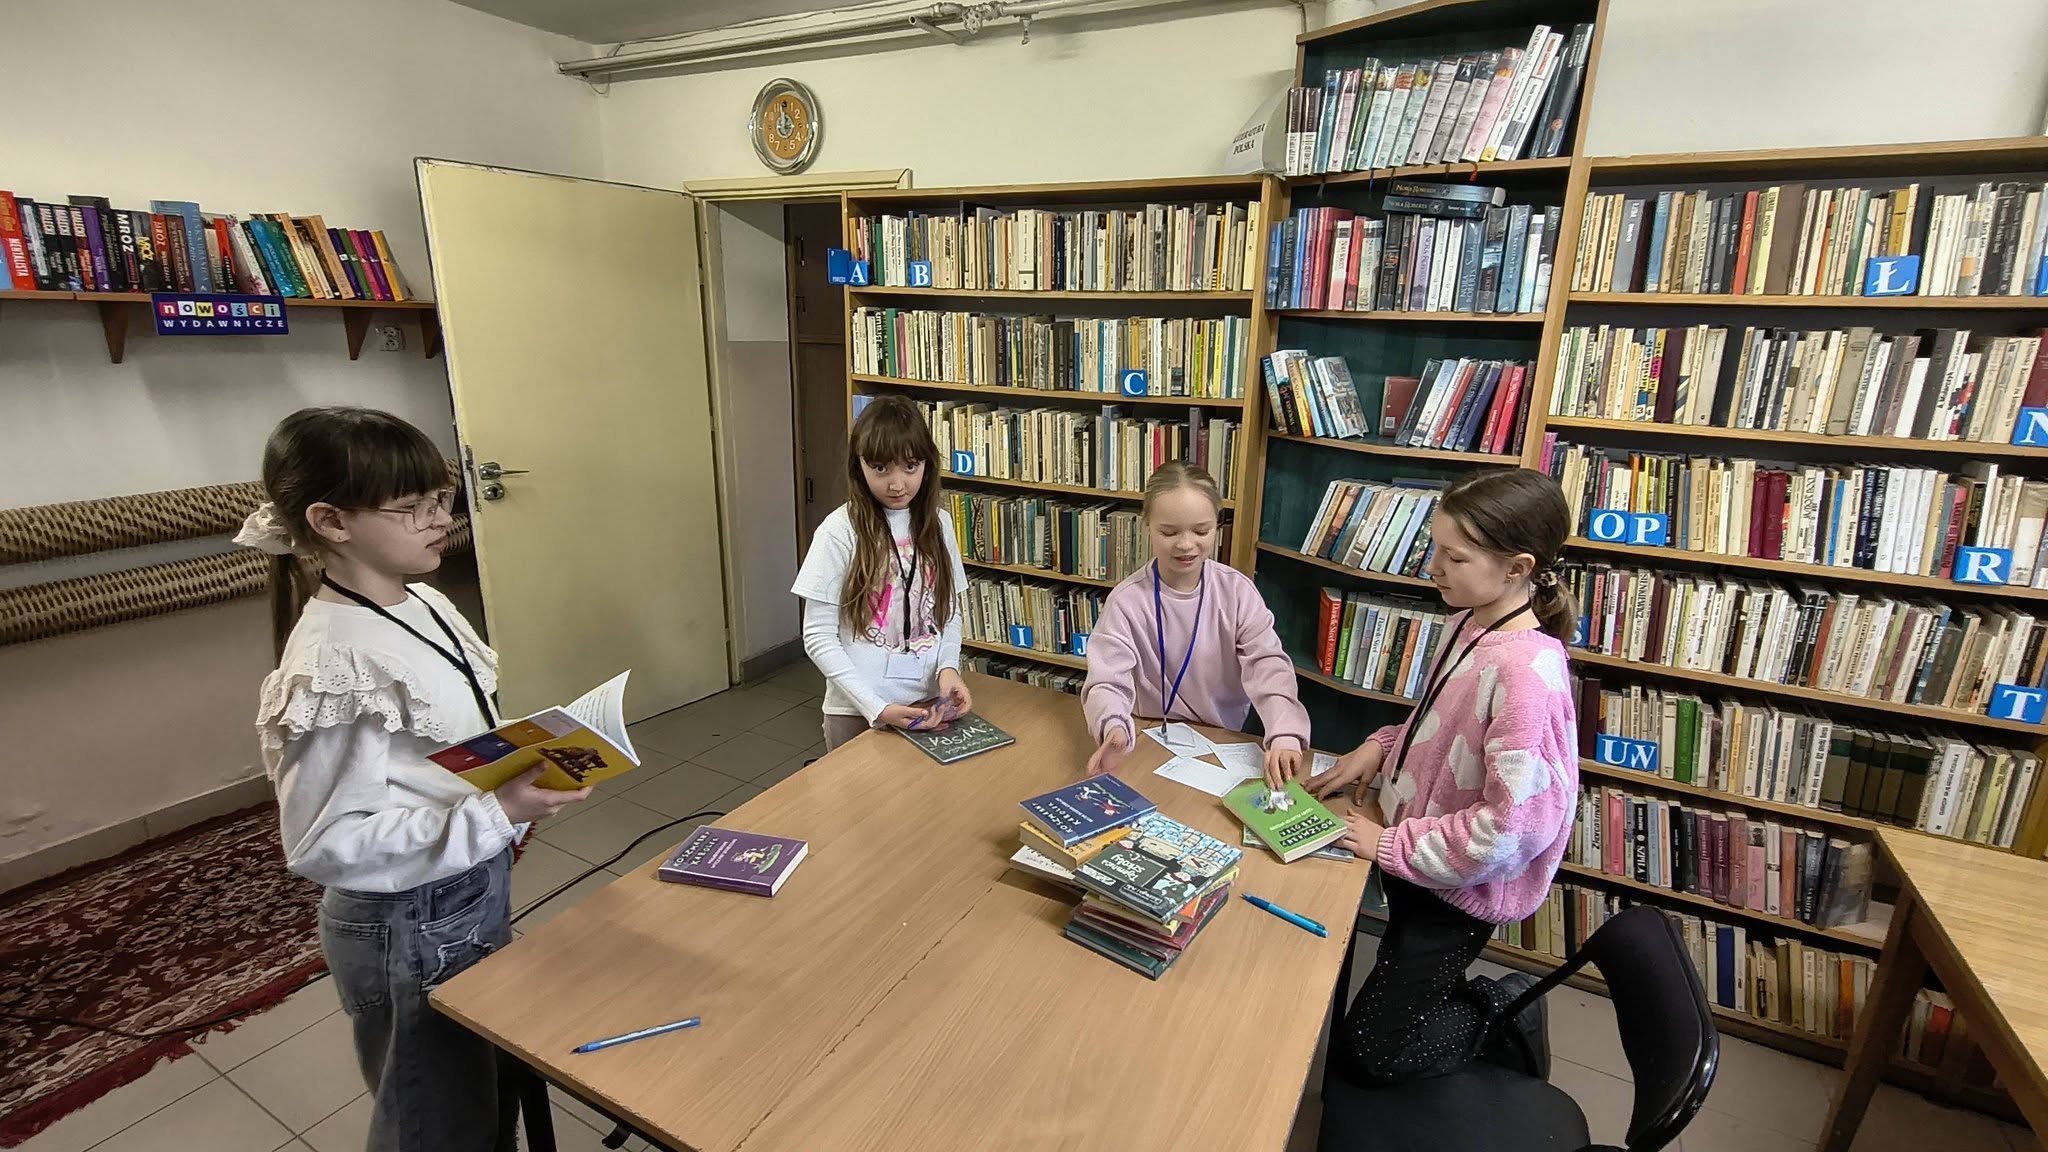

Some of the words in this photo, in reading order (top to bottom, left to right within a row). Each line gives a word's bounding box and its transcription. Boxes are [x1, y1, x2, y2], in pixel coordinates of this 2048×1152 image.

[850, 262, 865, 283] A
[912, 264, 929, 286] B
[1872, 260, 1911, 294] Ł
[164, 303, 276, 316] nowości
[163, 320, 285, 328] WYDAWNICZE
[1123, 372, 1144, 395] C
[956, 453, 972, 473] D
[1966, 551, 2002, 583] R
[1017, 628, 1026, 646] I
[2003, 690, 2041, 721] T
